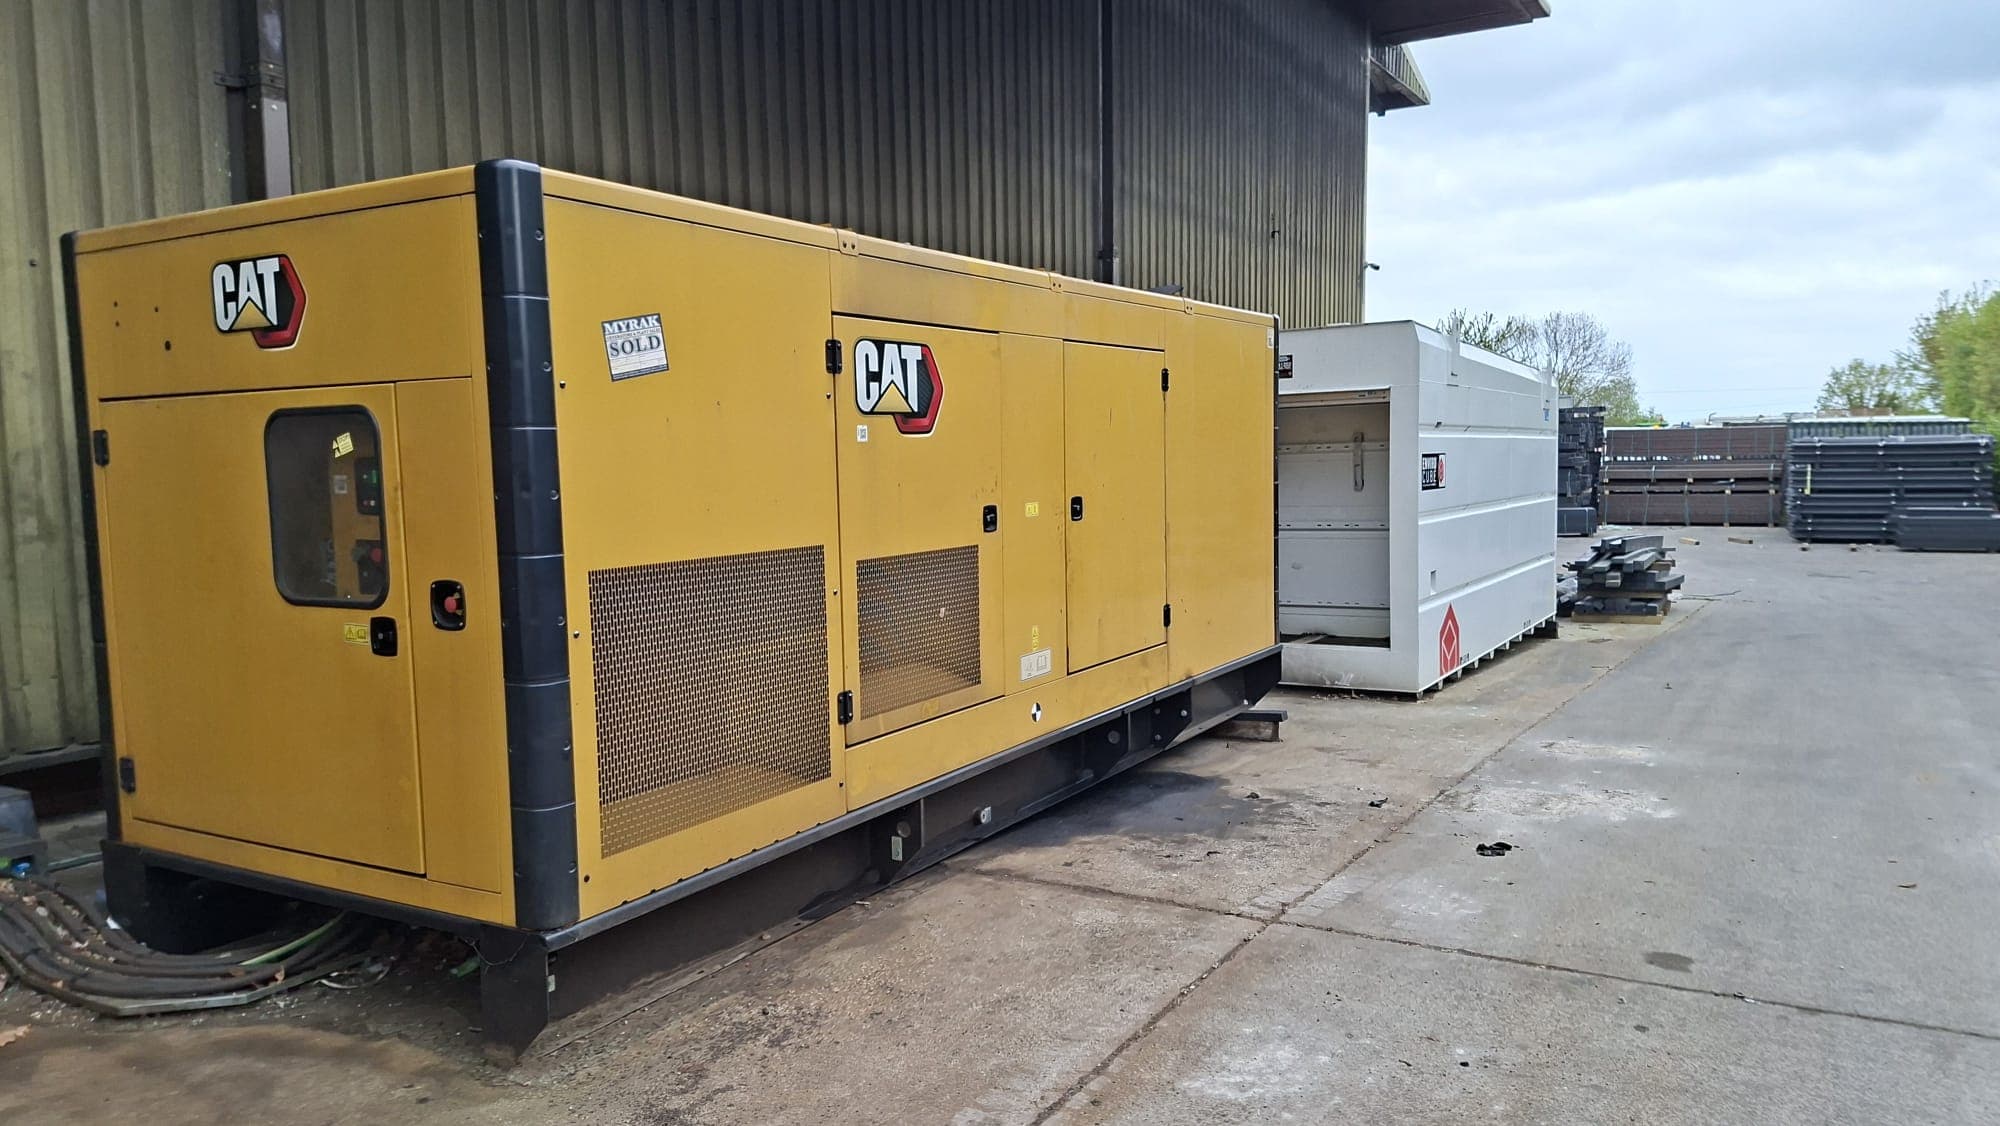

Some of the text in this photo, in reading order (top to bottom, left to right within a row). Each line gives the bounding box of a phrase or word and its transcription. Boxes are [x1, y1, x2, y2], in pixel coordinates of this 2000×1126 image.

[213, 257, 280, 331] CAT
[603, 315, 660, 334] MYRAK
[609, 335, 661, 357] SOLD
[855, 340, 922, 412] CAT
